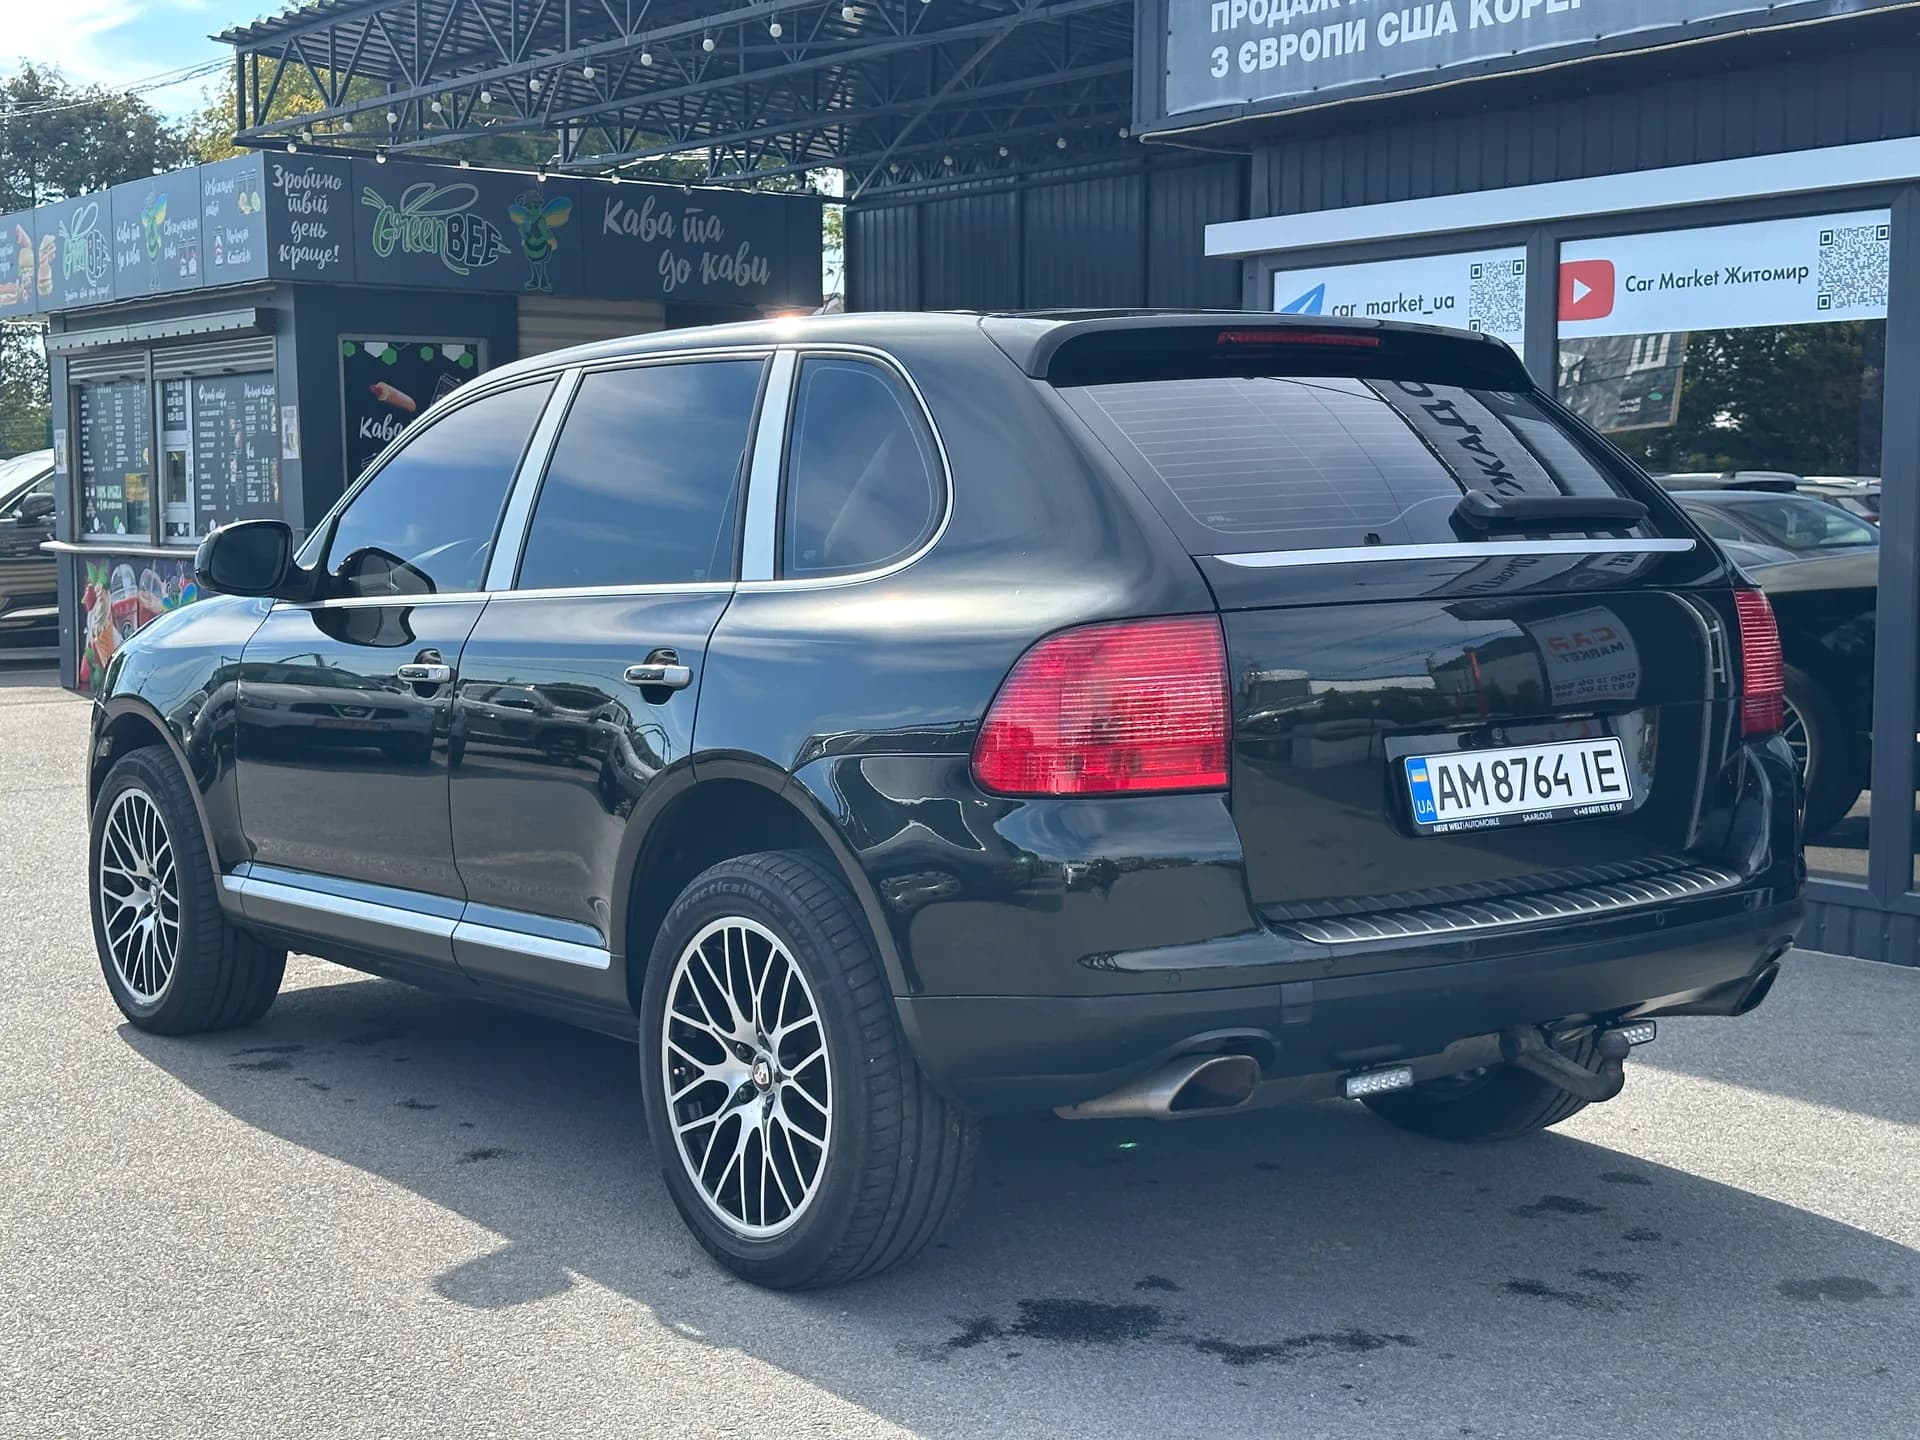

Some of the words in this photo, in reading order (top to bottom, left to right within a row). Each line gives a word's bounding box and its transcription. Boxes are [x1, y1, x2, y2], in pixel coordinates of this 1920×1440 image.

[1210, 46, 1229, 78] З
[1238, 19, 1366, 73] ЄВРОПИ
[1376, 2, 1459, 47] США
[1469, 0, 1581, 29] КОР
[272, 164, 342, 196] Зробимо
[287, 190, 329, 215] твій
[291, 220, 328, 243] день
[603, 195, 677, 242] Кава
[682, 208, 725, 244] та
[278, 244, 339, 271] краще!
[658, 249, 692, 293] до
[700, 241, 771, 287] кави
[1625, 276, 1654, 293] Car
[1658, 268, 1720, 291] Market
[1724, 264, 1809, 284] Житомир
[359, 413, 403, 442] Кава
[1417, 800, 1435, 814] UA
[1522, 811, 1553, 822] SAARLOUIS
